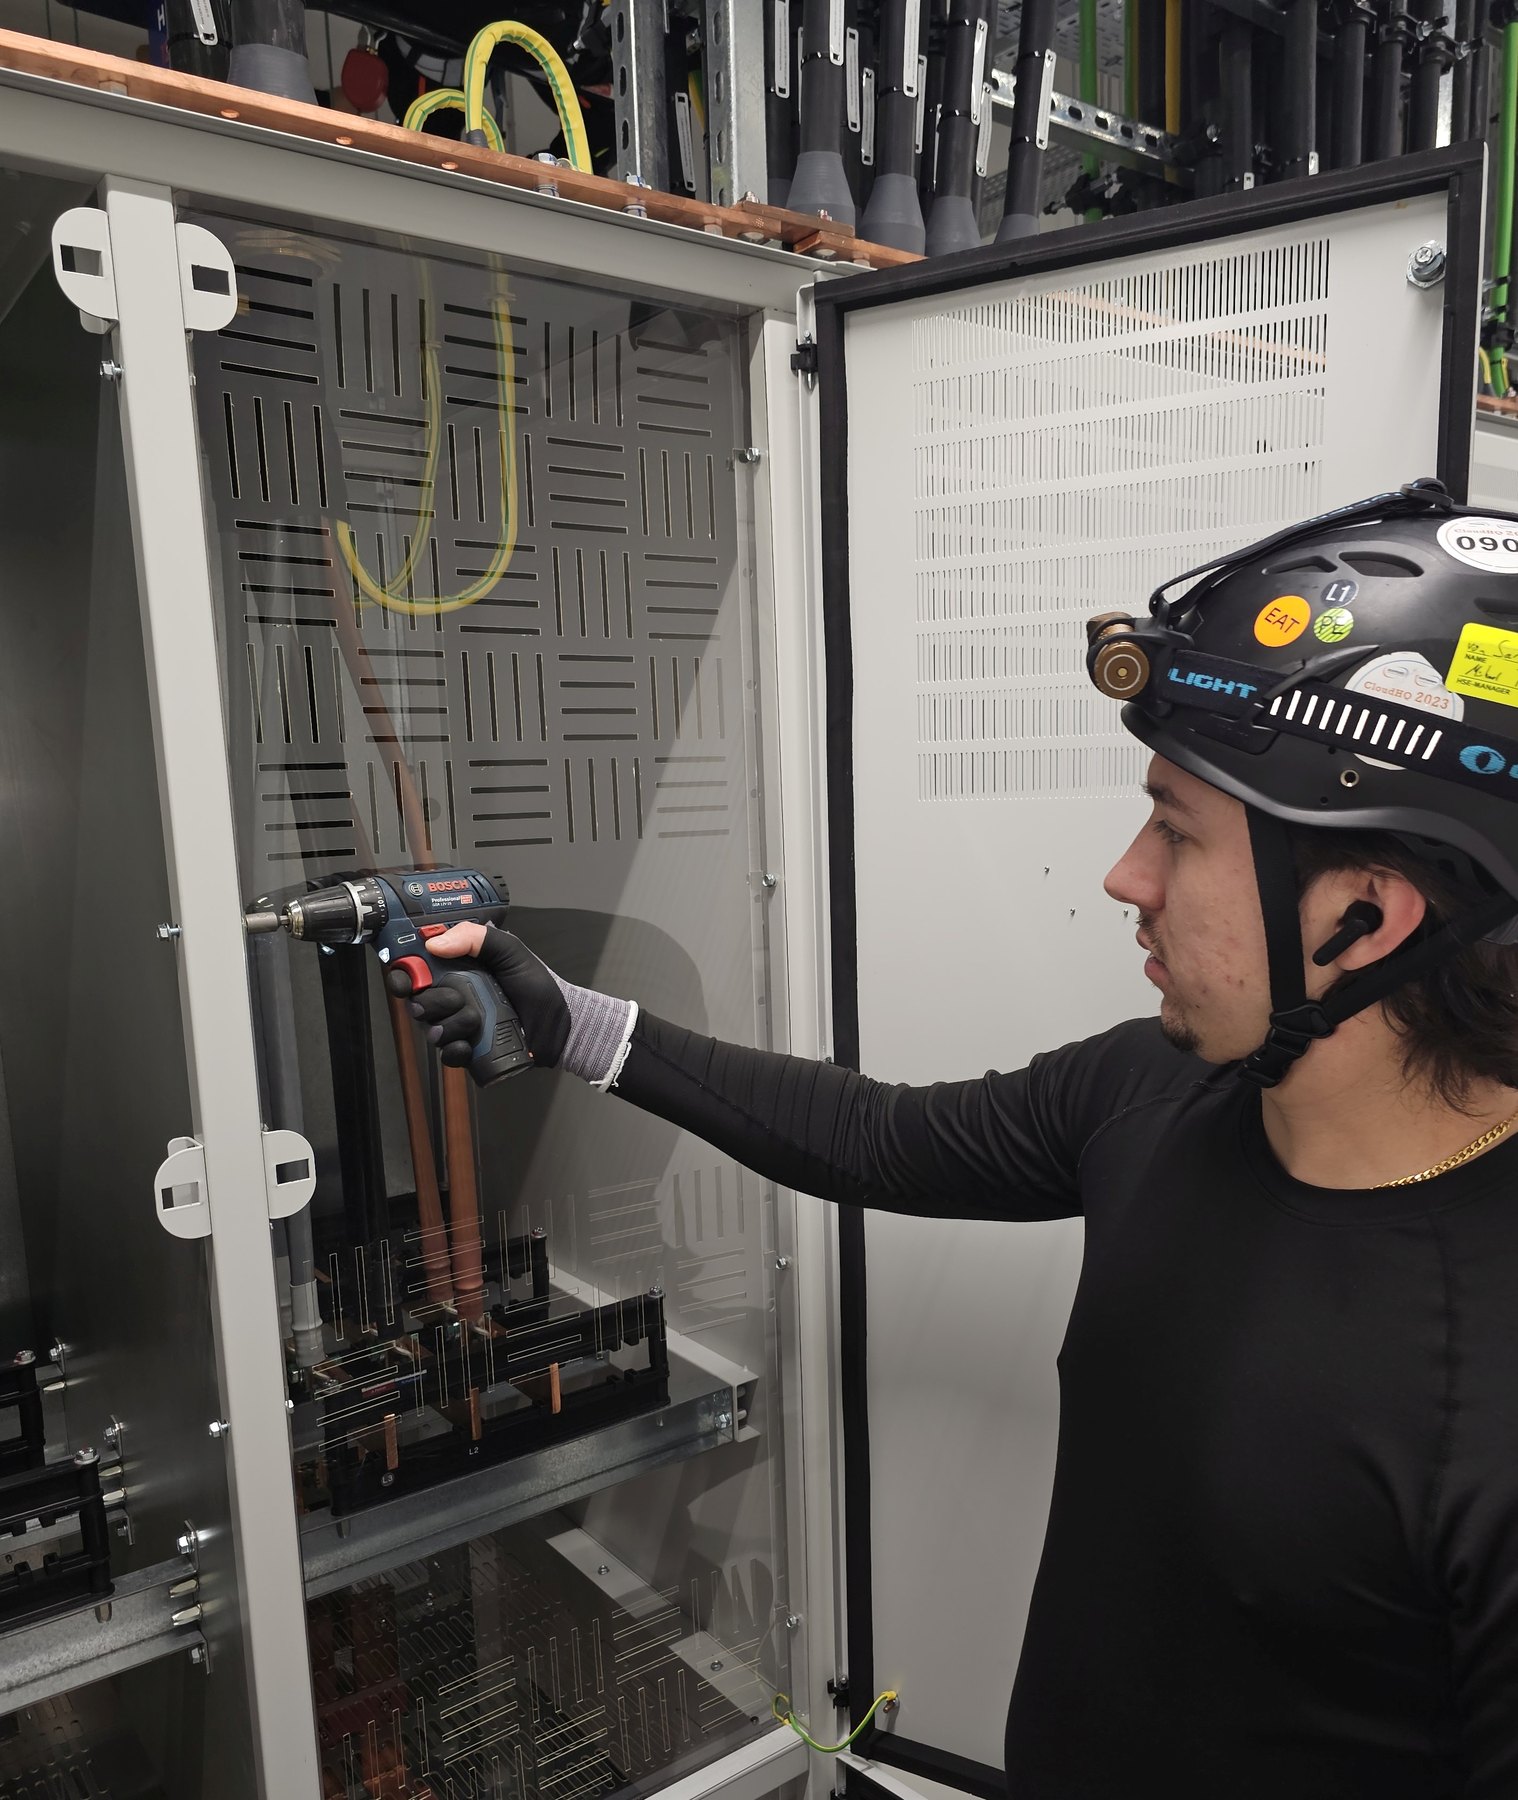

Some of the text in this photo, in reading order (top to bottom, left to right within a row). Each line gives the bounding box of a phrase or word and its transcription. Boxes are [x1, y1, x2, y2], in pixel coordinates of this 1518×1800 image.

[1456, 535, 1518, 552] 090
[1325, 583, 1351, 602] L1
[1264, 607, 1300, 633] EAT
[1464, 653, 1487, 663] NAME
[1168, 667, 1257, 699] LIGHT
[1456, 677, 1511, 696] HSE-MANAGER
[1415, 691, 1449, 709] 2023
[427, 879, 469, 893] BOSCH
[468, 1446, 479, 1455] L2
[382, 1474, 393, 1484] L3
